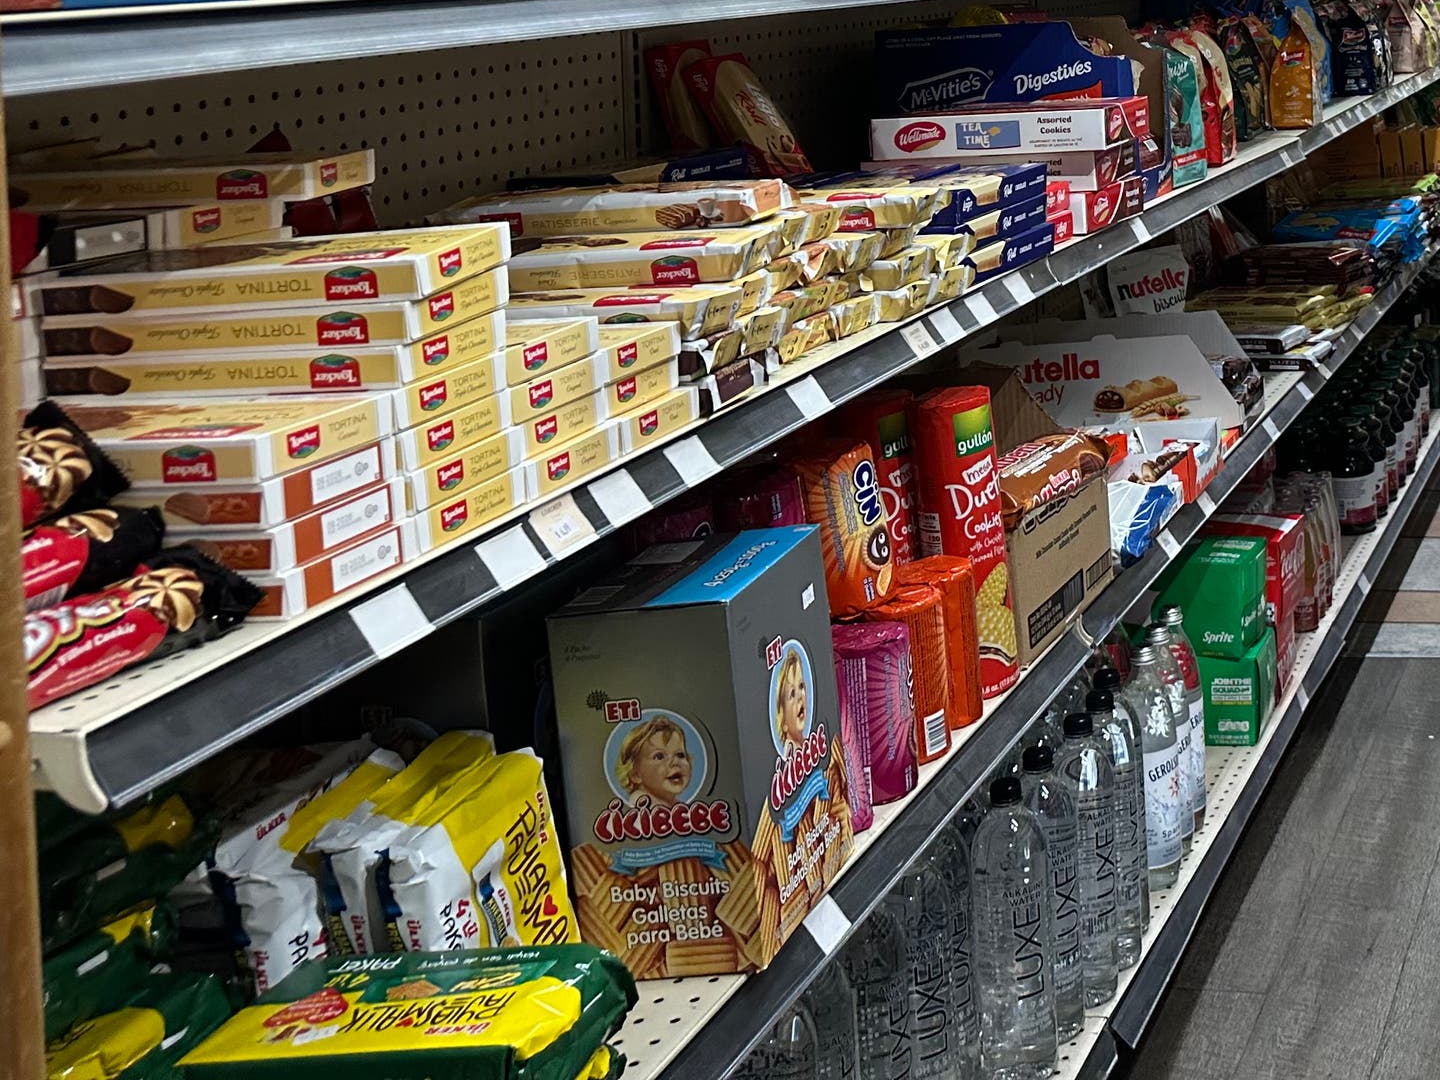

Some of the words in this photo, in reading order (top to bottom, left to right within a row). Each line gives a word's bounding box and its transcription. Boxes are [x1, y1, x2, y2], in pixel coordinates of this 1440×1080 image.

[1012, 59, 1093, 96] Digestives
[960, 122, 983, 133] TEA
[1036, 115, 1073, 125] Assorted
[898, 123, 942, 147] Wellmade
[963, 134, 991, 147] TIME
[1040, 126, 1072, 135] Cookies
[533, 216, 601, 229] PATISSERIE
[569, 267, 642, 281] PATISSERIE
[1116, 266, 1185, 301] nutella
[235, 278, 313, 295] TORTINA
[230, 323, 307, 338] TORTINA
[454, 326, 487, 344] TORTINA
[226, 365, 300, 380] TORTINA
[452, 370, 487, 388] TORTINA
[327, 412, 368, 434] TORTINA
[460, 408, 492, 426] TORTINA
[884, 435, 911, 455] gull
[957, 428, 992, 456] gullón
[469, 446, 502, 464] TORTINA
[966, 461, 992, 483] mega
[472, 486, 506, 504] TORTINA
[93, 623, 137, 647] Cookie
[1202, 630, 1234, 648] Sprite
[256, 811, 287, 840] ÜLKER
[534, 791, 549, 846] ÜLKER
[787, 834, 807, 868] Baby
[610, 884, 657, 905] Baby
[662, 877, 730, 899] Biscuits
[779, 862, 810, 904] Galletas
[1009, 892, 1042, 908] WATER
[632, 904, 708, 925] Galletas
[1054, 863, 1080, 958] LUXE
[627, 928, 670, 949] para
[675, 919, 724, 942] Bebé
[1012, 903, 1046, 1002] LUXE
[913, 957, 948, 1061] LUXE
